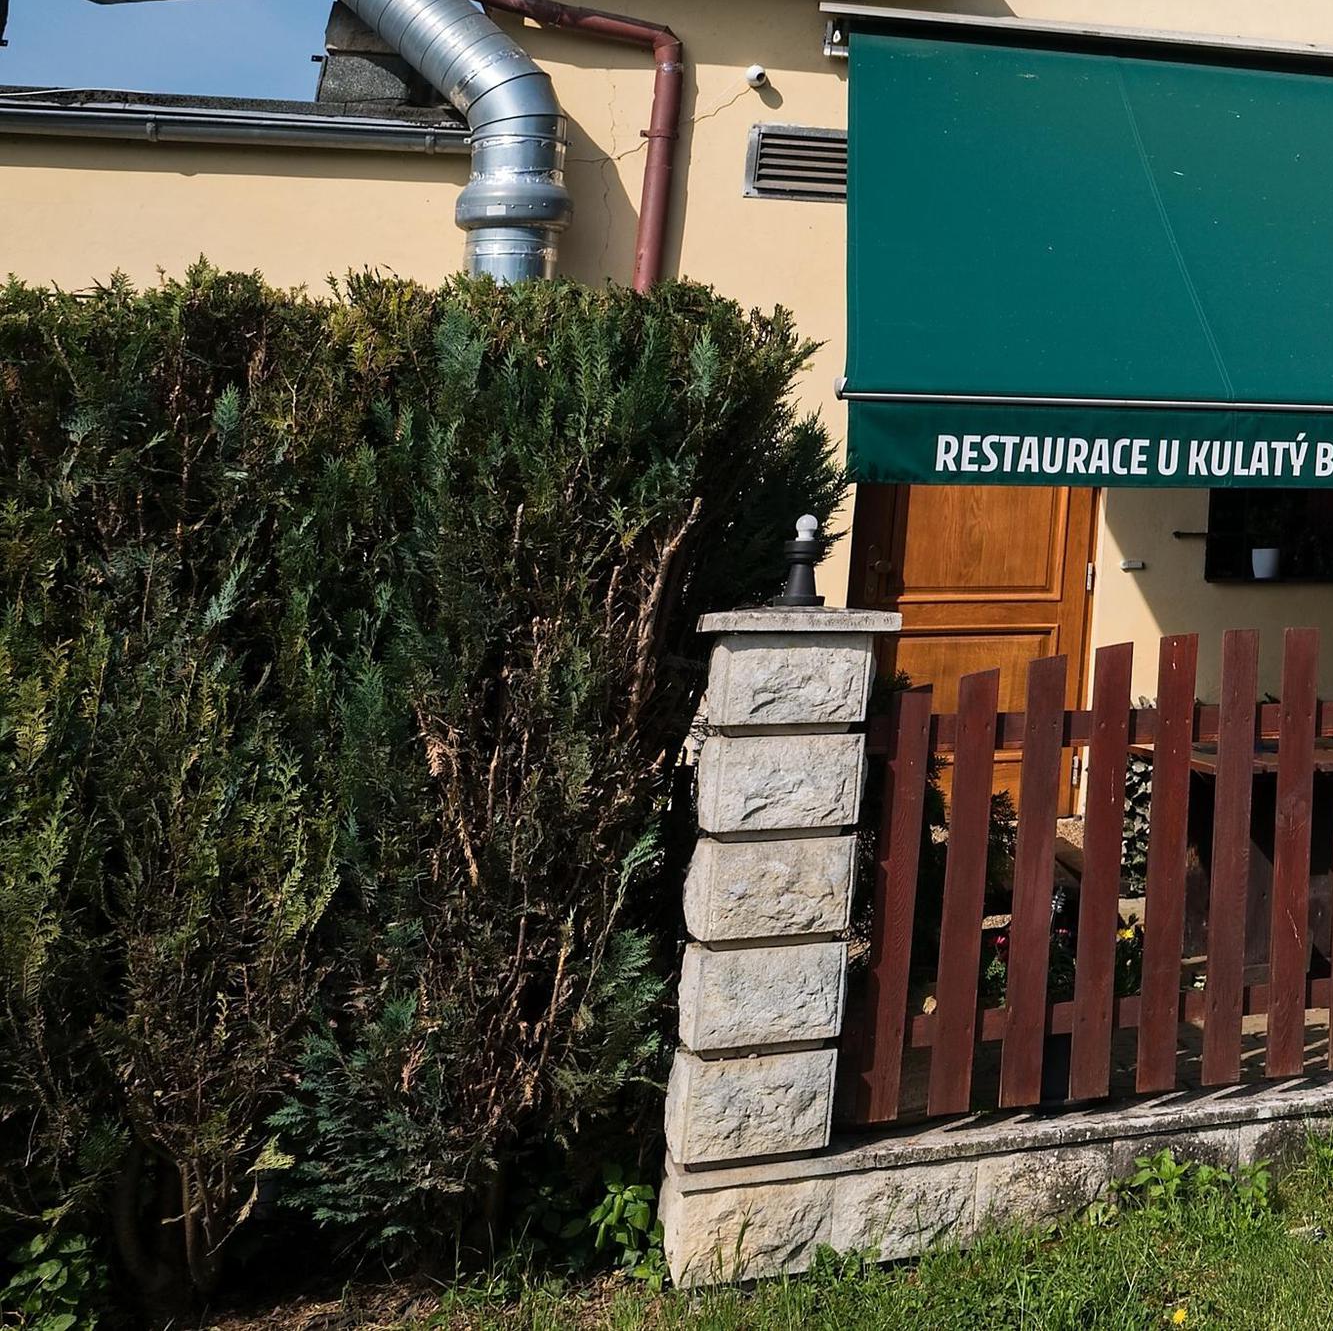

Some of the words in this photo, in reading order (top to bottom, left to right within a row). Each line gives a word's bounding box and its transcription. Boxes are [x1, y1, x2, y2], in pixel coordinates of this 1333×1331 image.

[935, 434, 1149, 476] RESTAURACE
[1158, 440, 1180, 476] U
[1188, 432, 1307, 477] KULATÝ
